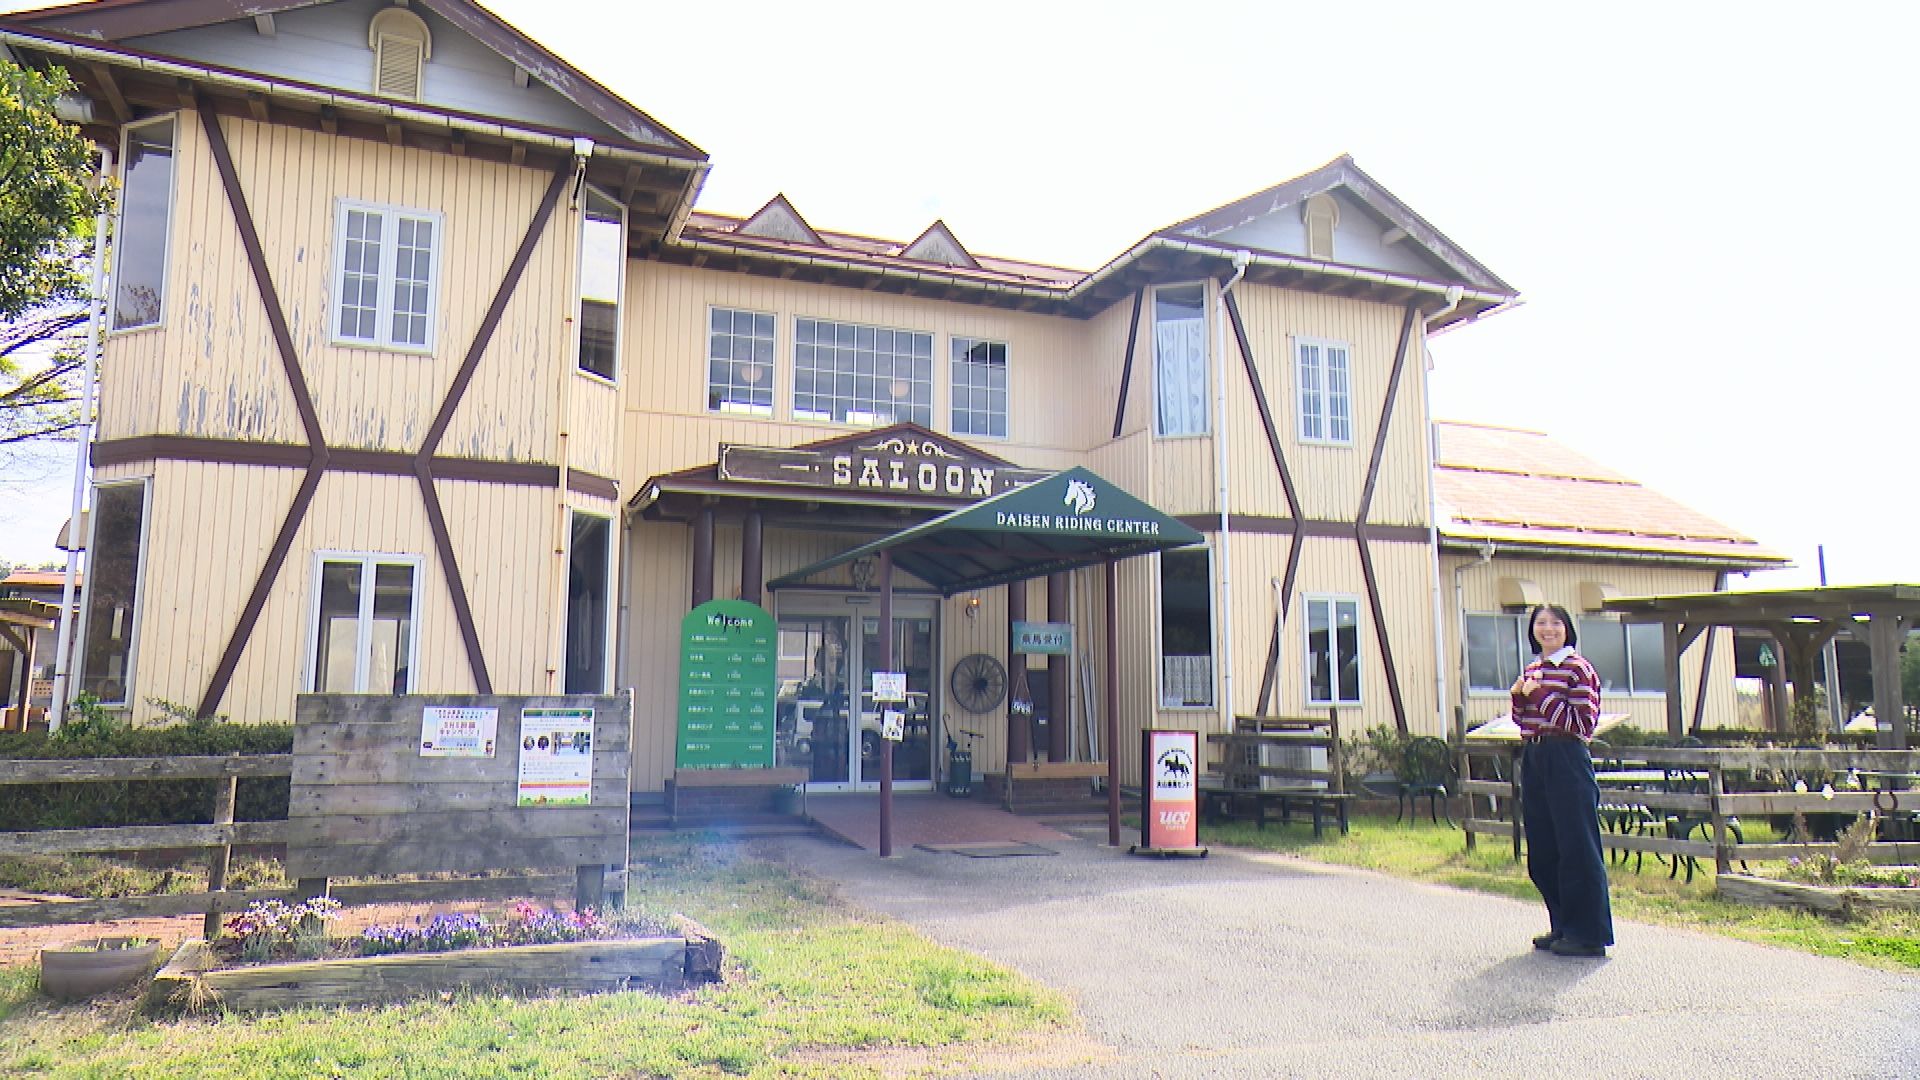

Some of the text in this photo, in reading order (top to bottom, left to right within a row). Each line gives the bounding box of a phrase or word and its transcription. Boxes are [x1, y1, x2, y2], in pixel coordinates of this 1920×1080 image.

[833, 455, 995, 496] SALOON
[996, 511, 1160, 535] DAISEN RIDING CENTER
[707, 614, 753, 627] Welcome
